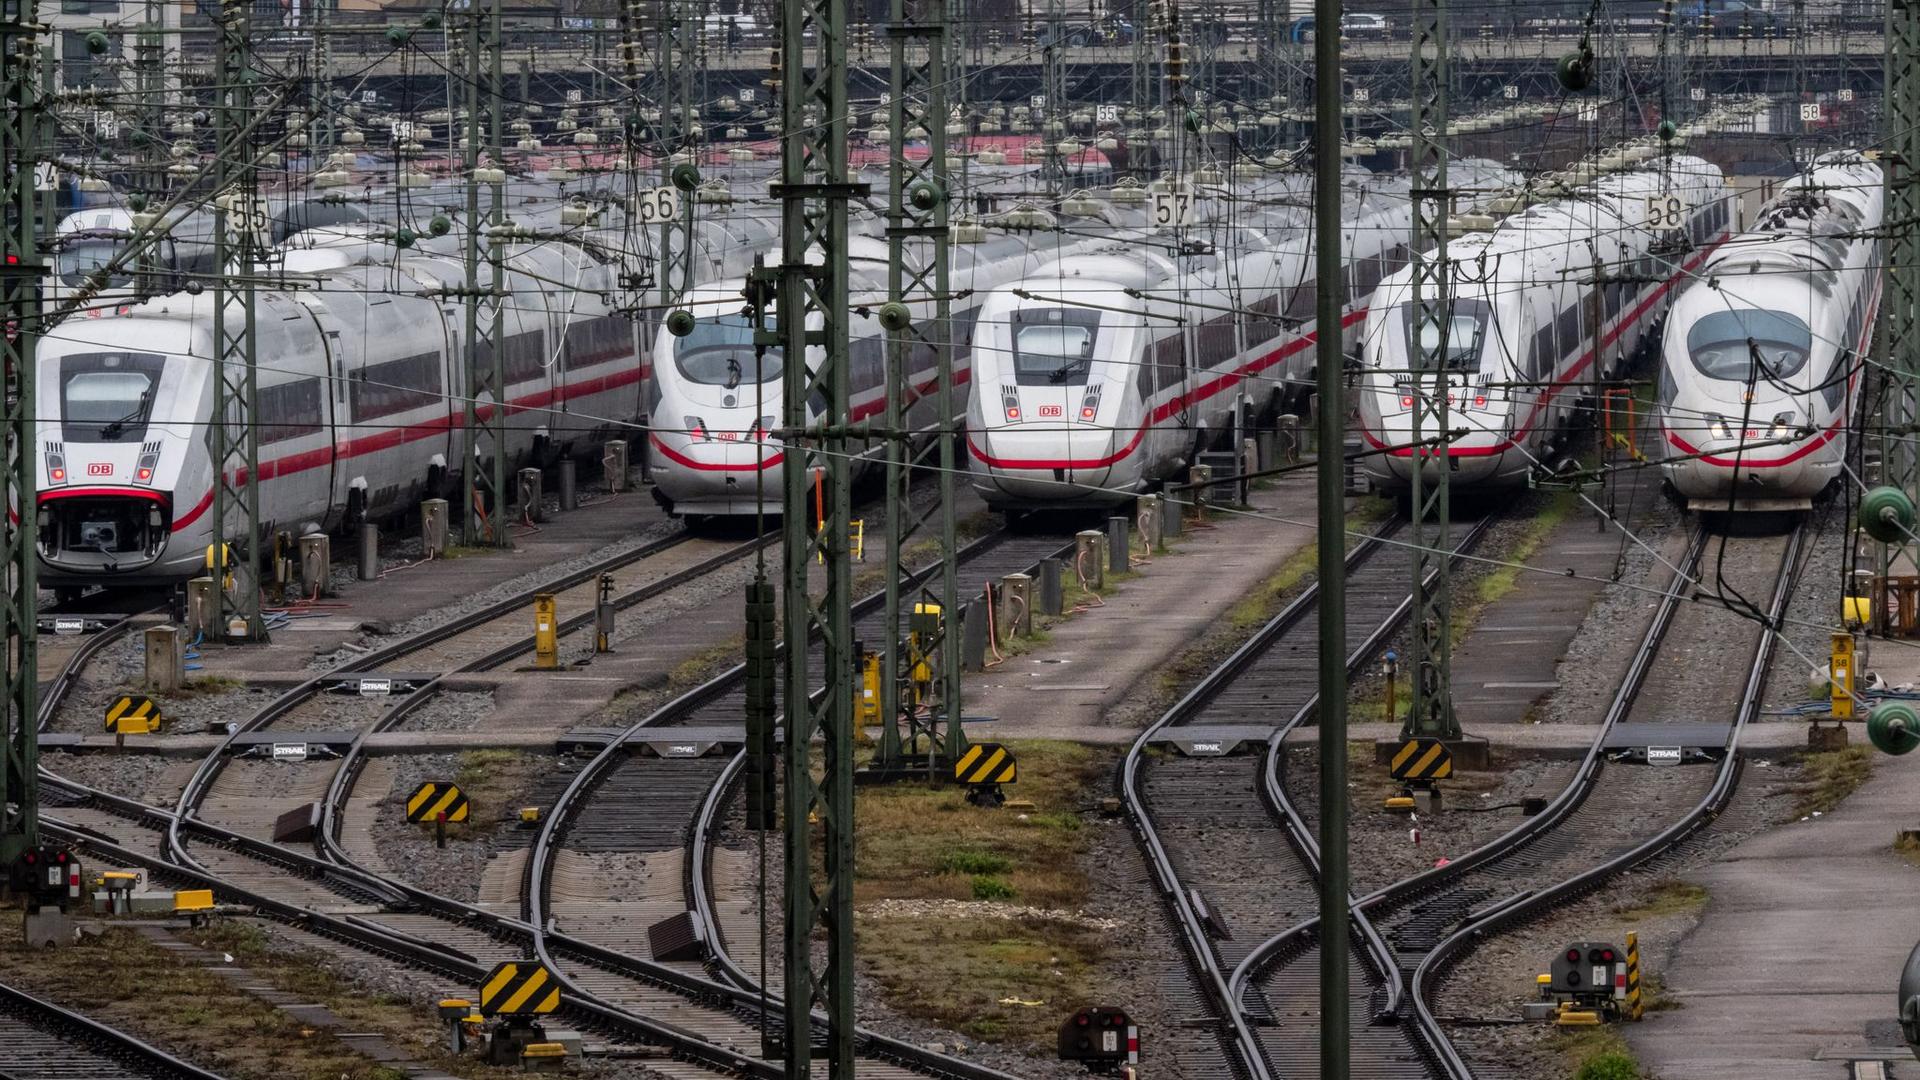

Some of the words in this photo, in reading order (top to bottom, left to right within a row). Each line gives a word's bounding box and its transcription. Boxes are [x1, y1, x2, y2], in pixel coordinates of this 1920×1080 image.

[1840, 90, 1851, 101] 58
[1099, 106, 1115, 120] 55
[1803, 105, 1819, 120] 58
[640, 189, 673, 220] 56
[1156, 194, 1188, 224] 57
[233, 200, 266, 229] 55
[1648, 196, 1681, 226] 58
[1041, 407, 1060, 416] DB
[90, 464, 111, 475] DB
[1835, 659, 1847, 667] 58
[361, 682, 389, 690] STRAIL
[275, 747, 306, 755] STRAIL
[1650, 750, 1680, 758] STRAIL
